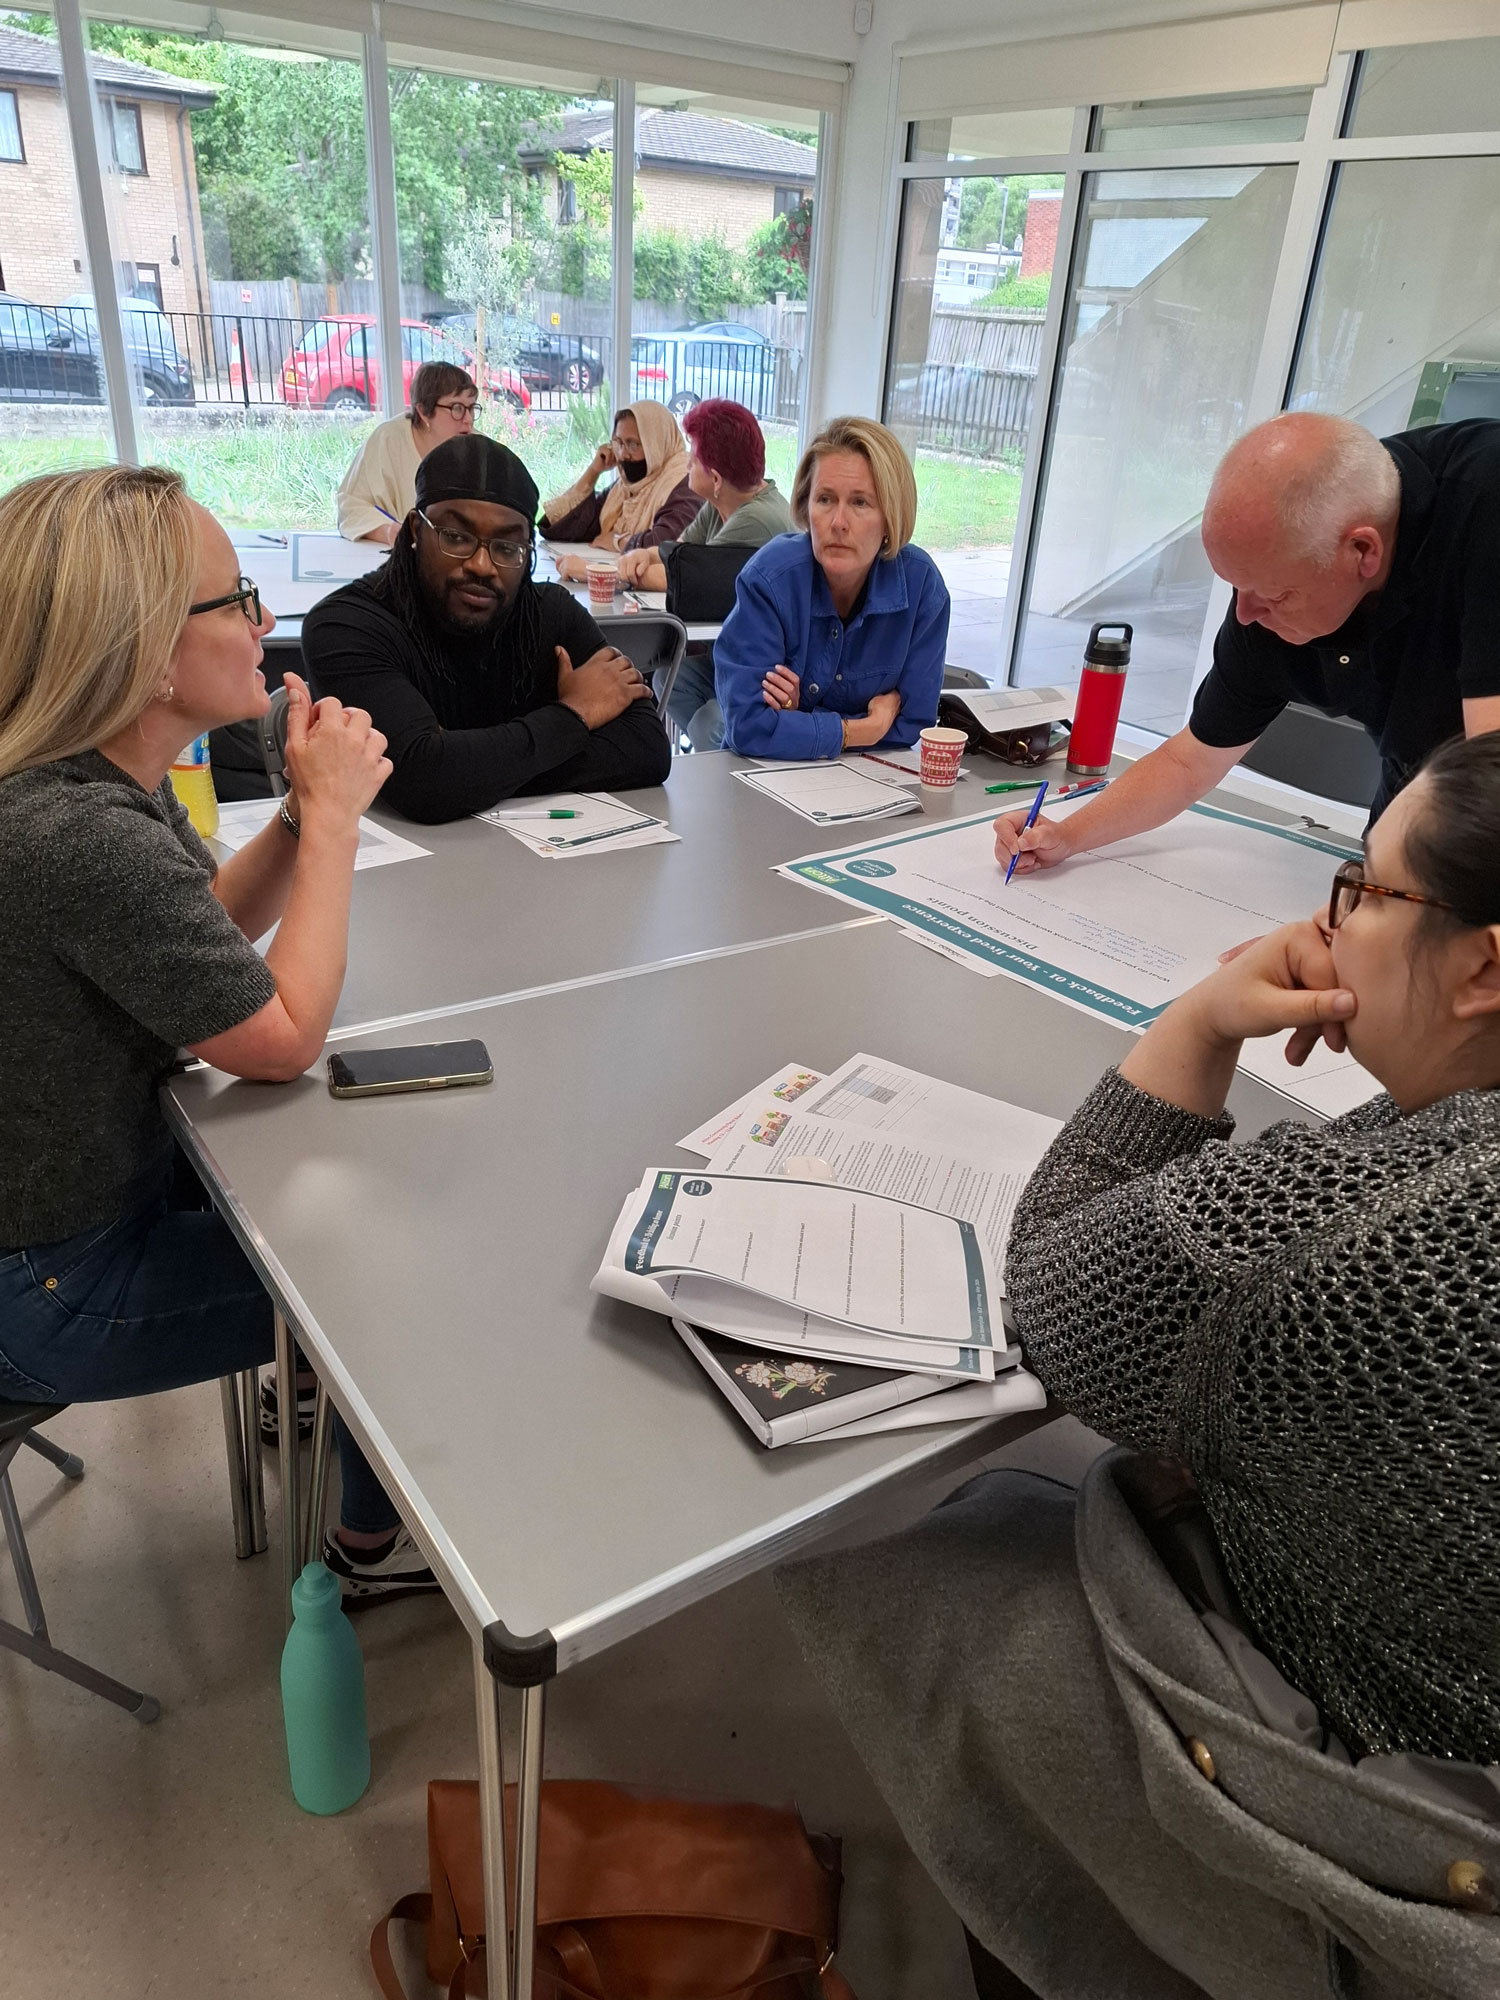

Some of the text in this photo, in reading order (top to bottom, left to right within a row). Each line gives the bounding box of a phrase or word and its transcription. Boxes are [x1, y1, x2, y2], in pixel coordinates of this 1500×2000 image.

[802, 866, 837, 884] Alton
[925, 897, 969, 917] points
[983, 898, 996, 907] the
[995, 904, 1016, 917] about
[902, 903, 971, 939] experience
[1015, 914, 1032, 925] well
[969, 916, 1038, 951] Discussion
[1032, 922, 1054, 934] works
[1054, 932, 1072, 943] think
[971, 937, 1006, 956] lived
[1082, 944, 1098, 954] love
[1005, 952, 1041, 972] Your
[1121, 960, 1138, 970] you
[1049, 972, 1067, 983] 01
[1149, 972, 1171, 983] What
[1067, 980, 1142, 1015] Feedback
[658, 1174, 673, 1190] Alton
